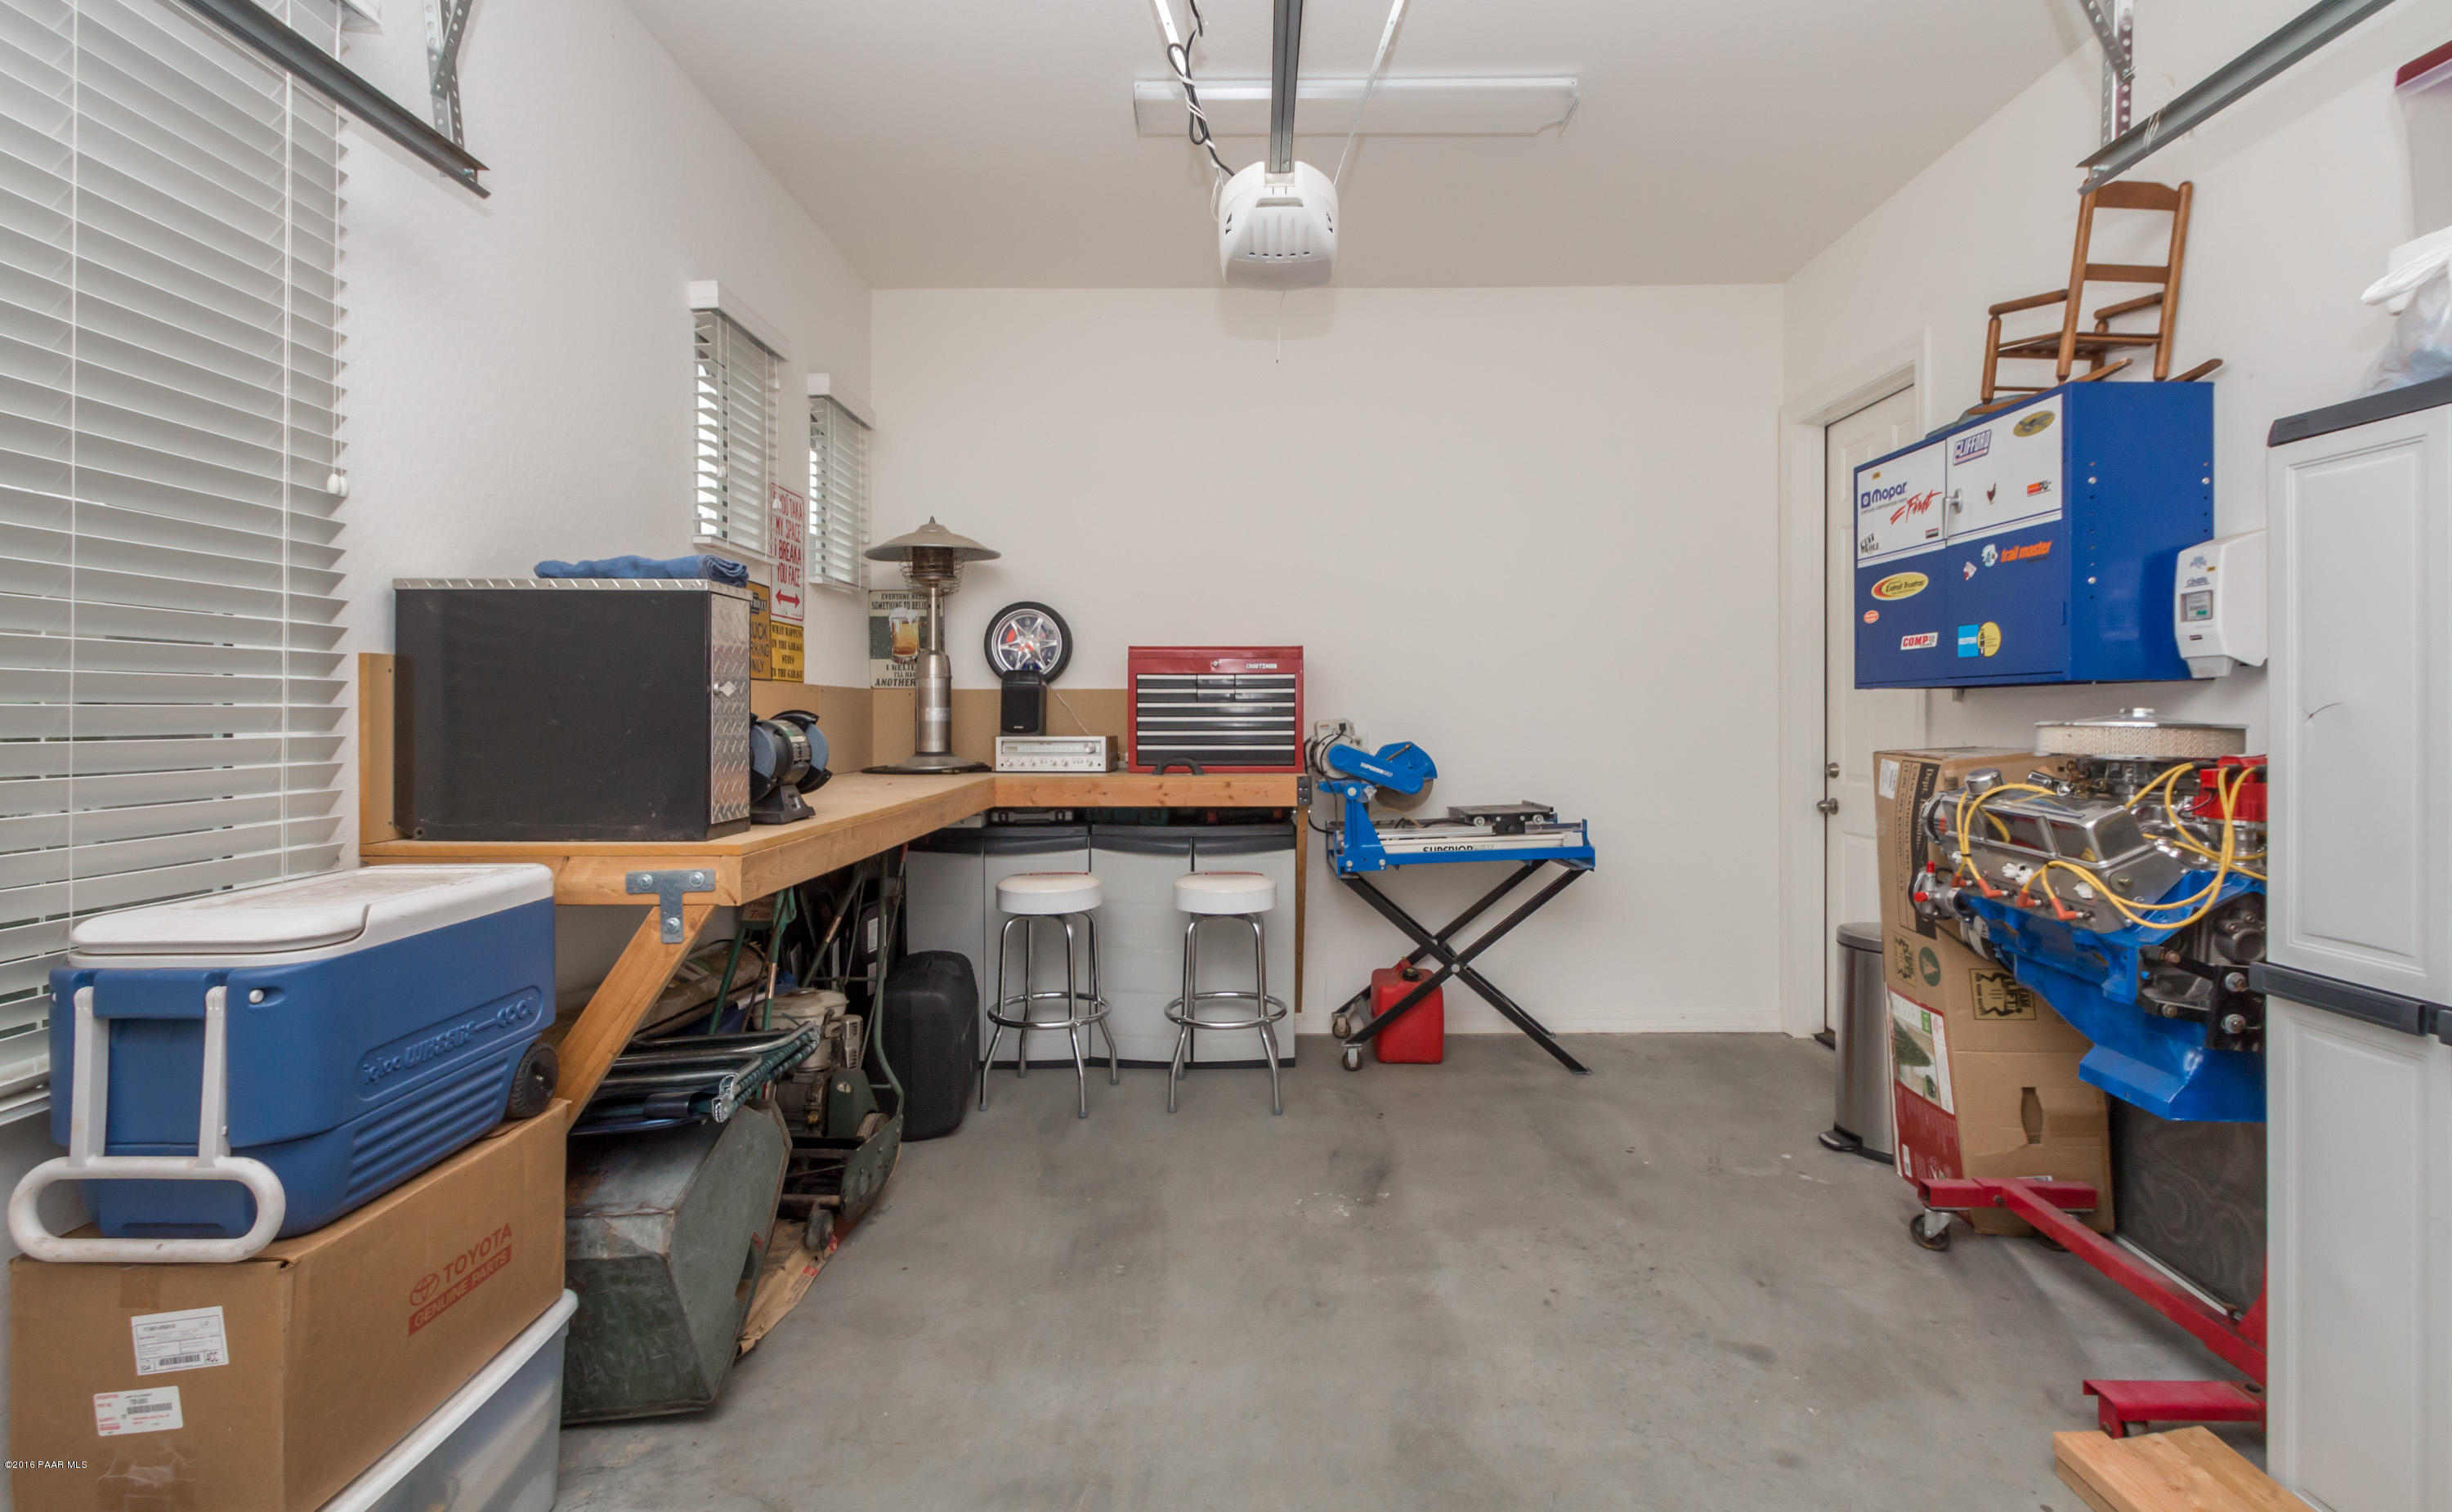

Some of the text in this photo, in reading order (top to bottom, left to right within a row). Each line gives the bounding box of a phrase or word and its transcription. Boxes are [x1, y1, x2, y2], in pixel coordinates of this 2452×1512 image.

[778, 492, 788, 516] YOU
[790, 498, 803, 522] TAKA
[776, 517, 800, 544] MY SPACE
[779, 539, 802, 565] BREAKA
[2019, 541, 2052, 559] master
[777, 562, 800, 588] YOU FACE
[871, 601, 902, 610] SOMETHING
[904, 601, 911, 610] TO
[772, 625, 784, 635] WHAT
[778, 640, 787, 650] THE
[1903, 635, 1929, 646] COMP
[751, 658, 764, 673] NLY
[781, 655, 794, 664] STAYS
[778, 668, 787, 677] THE
[875, 678, 916, 687] ANOTHER
[442, 1223, 512, 1282] TOYOTA
[414, 1250, 508, 1326] GENUINE PARTS
